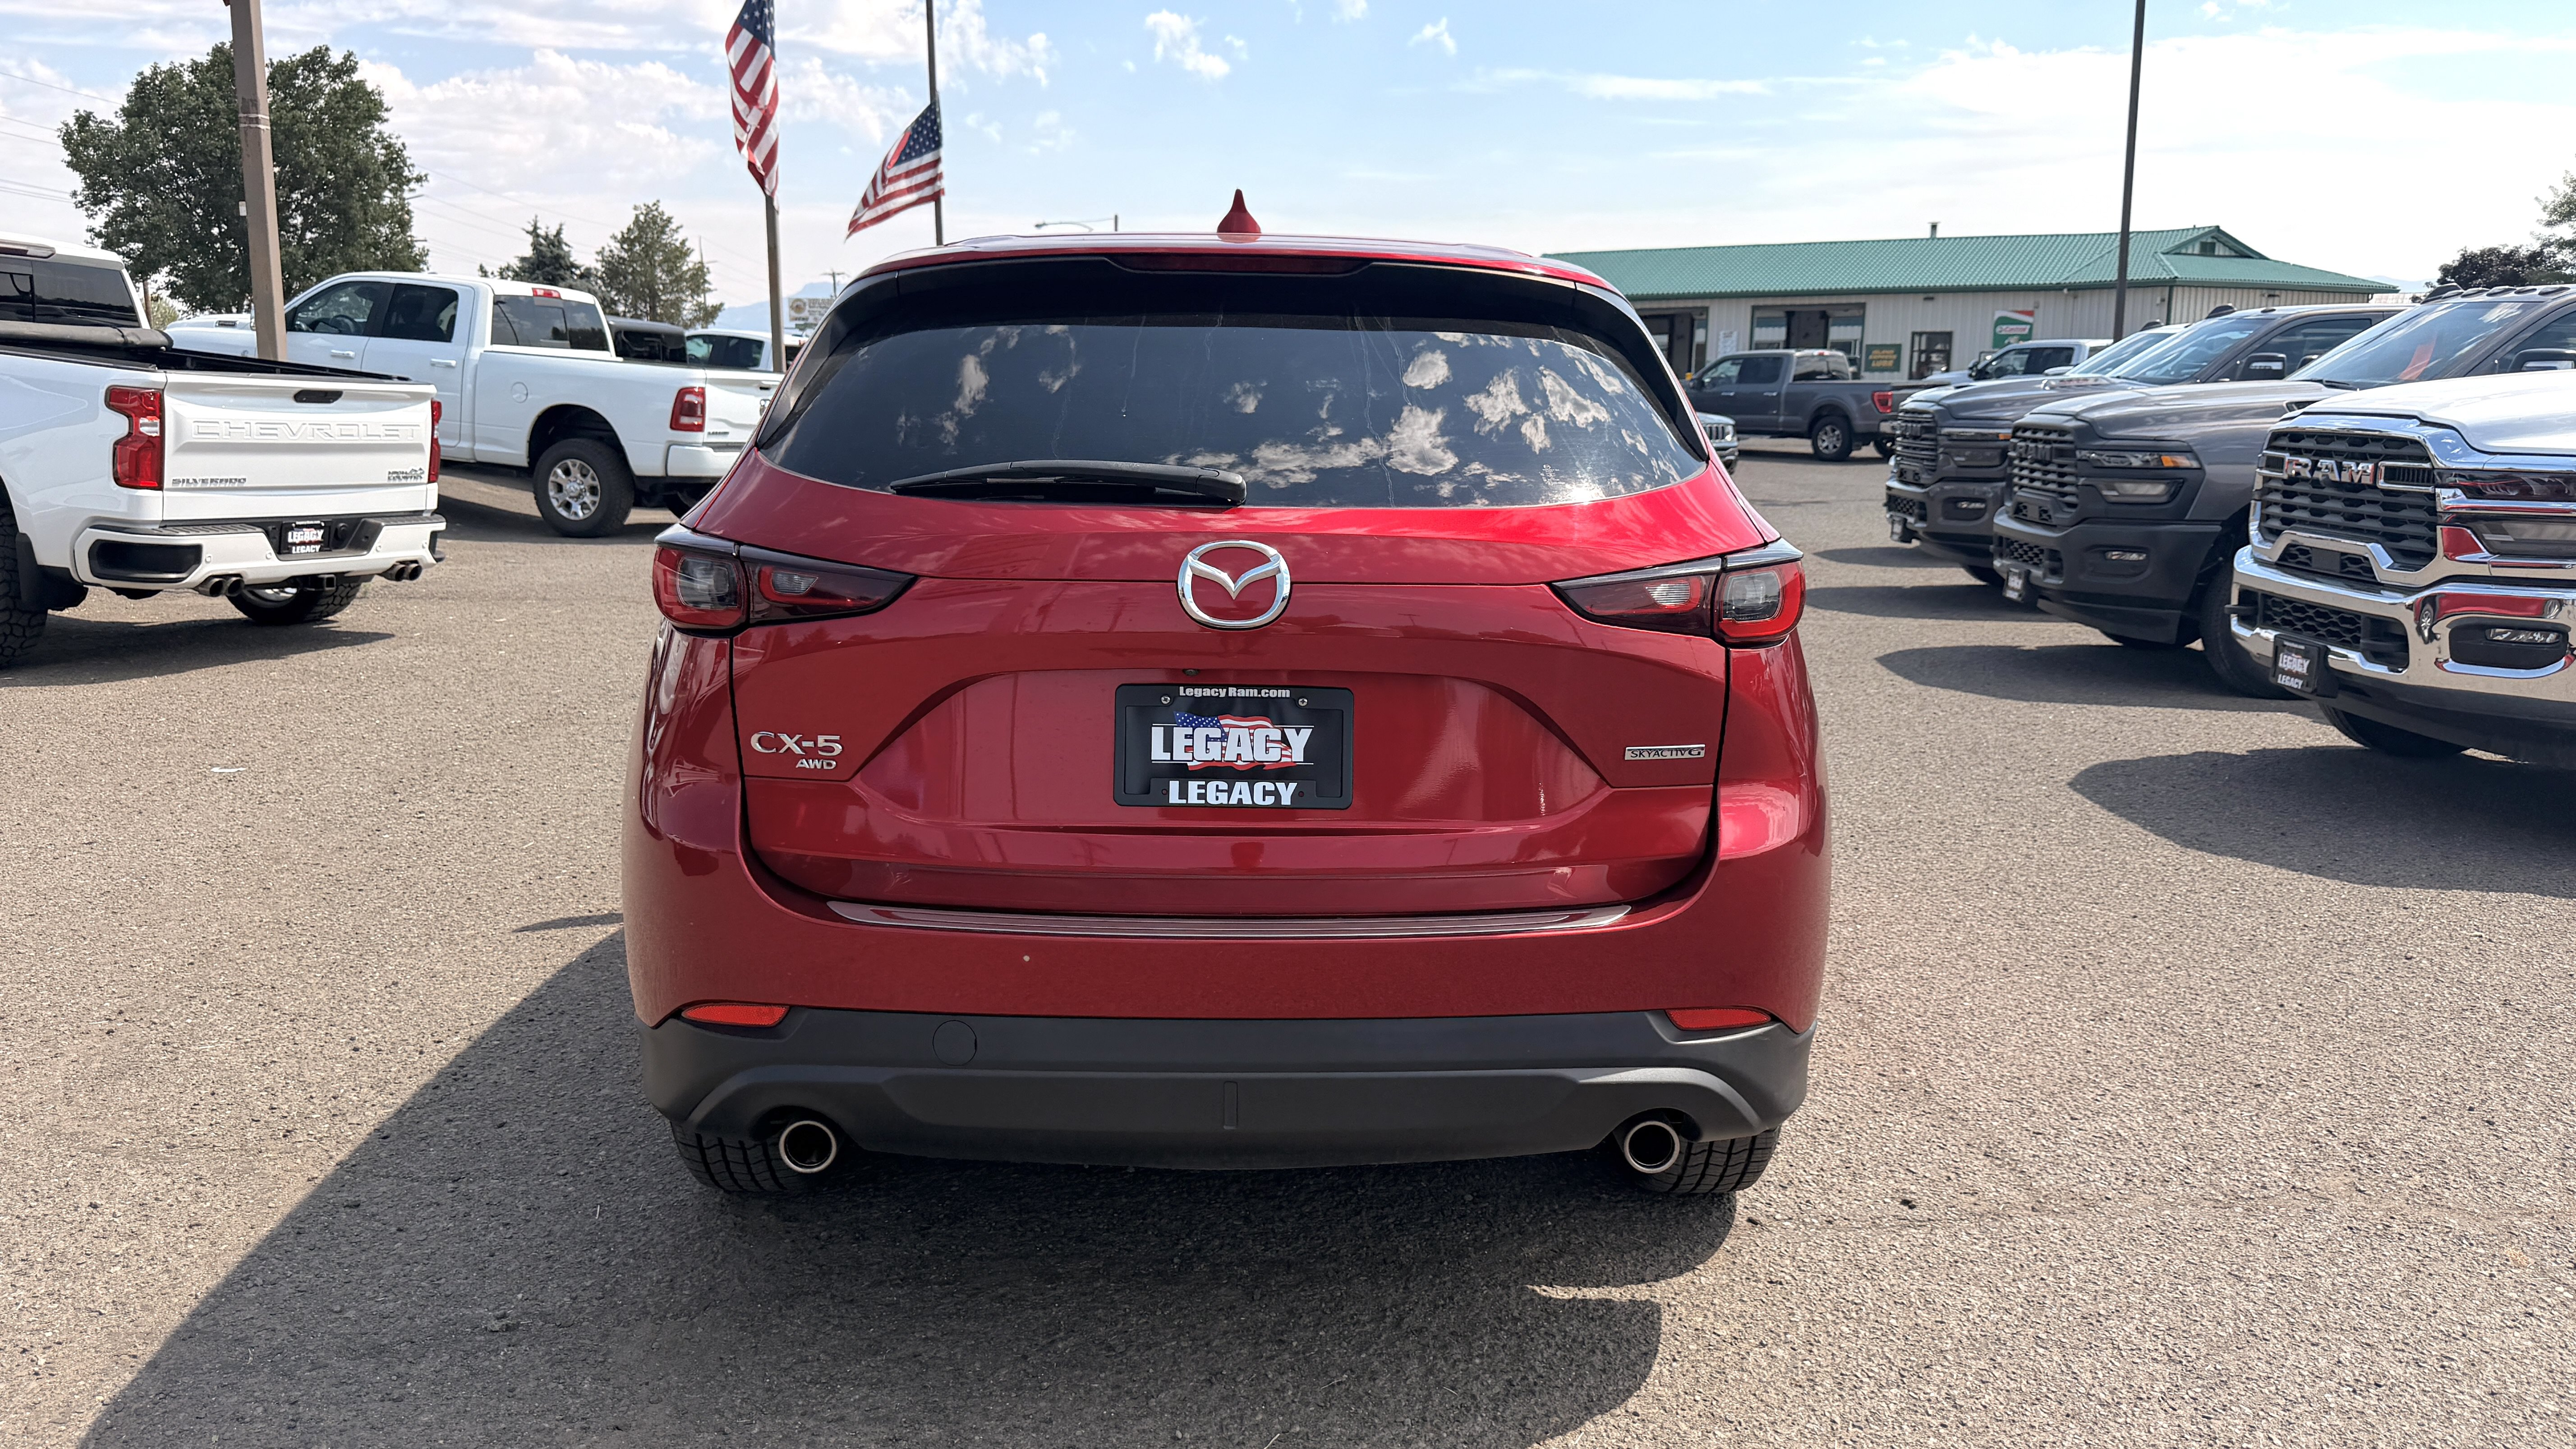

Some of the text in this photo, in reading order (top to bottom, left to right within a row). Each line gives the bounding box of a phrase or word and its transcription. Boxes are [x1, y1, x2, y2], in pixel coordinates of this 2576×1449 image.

[192, 420, 420, 440] CHEVROLET
[2017, 442, 2052, 460] RAM
[2285, 456, 2374, 484] RAM
[288, 529, 324, 543] LEGACY
[292, 545, 321, 554] LEGACY
[2278, 653, 2310, 673] LEGACY
[2277, 674, 2303, 689] LEGACY
[750, 731, 842, 756] CX-5
[1151, 726, 1313, 763] LEGACY
[796, 759, 837, 769] AWD
[1169, 780, 1297, 805] LEGACY
